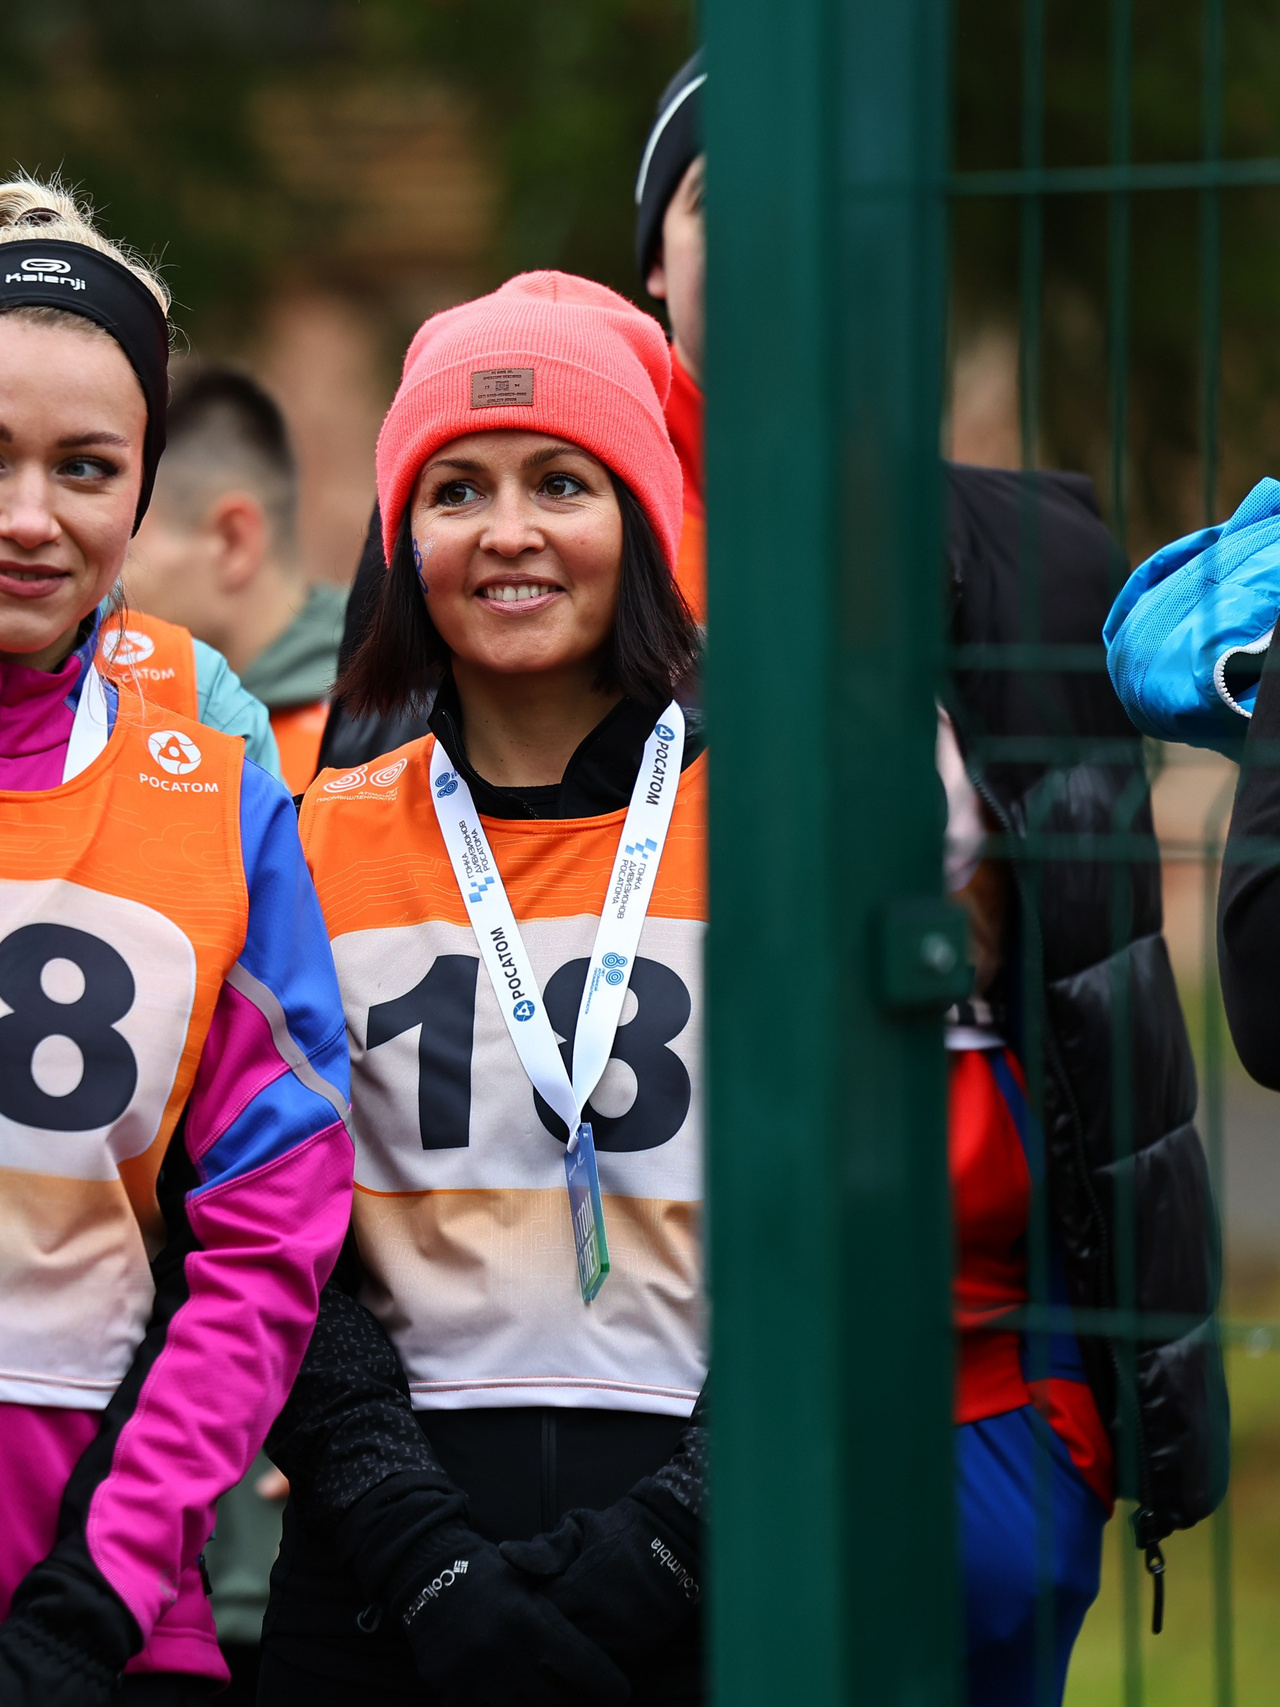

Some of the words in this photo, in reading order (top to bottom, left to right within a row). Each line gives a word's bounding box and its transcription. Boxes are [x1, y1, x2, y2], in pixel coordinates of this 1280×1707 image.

[113, 668, 176, 683] САТОМ
[139, 772, 219, 793] РОСАТОМ
[646, 740, 669, 806] РОСАТОМ
[490, 927, 525, 1000] РОСАТОМ
[366, 954, 692, 1152] 18
